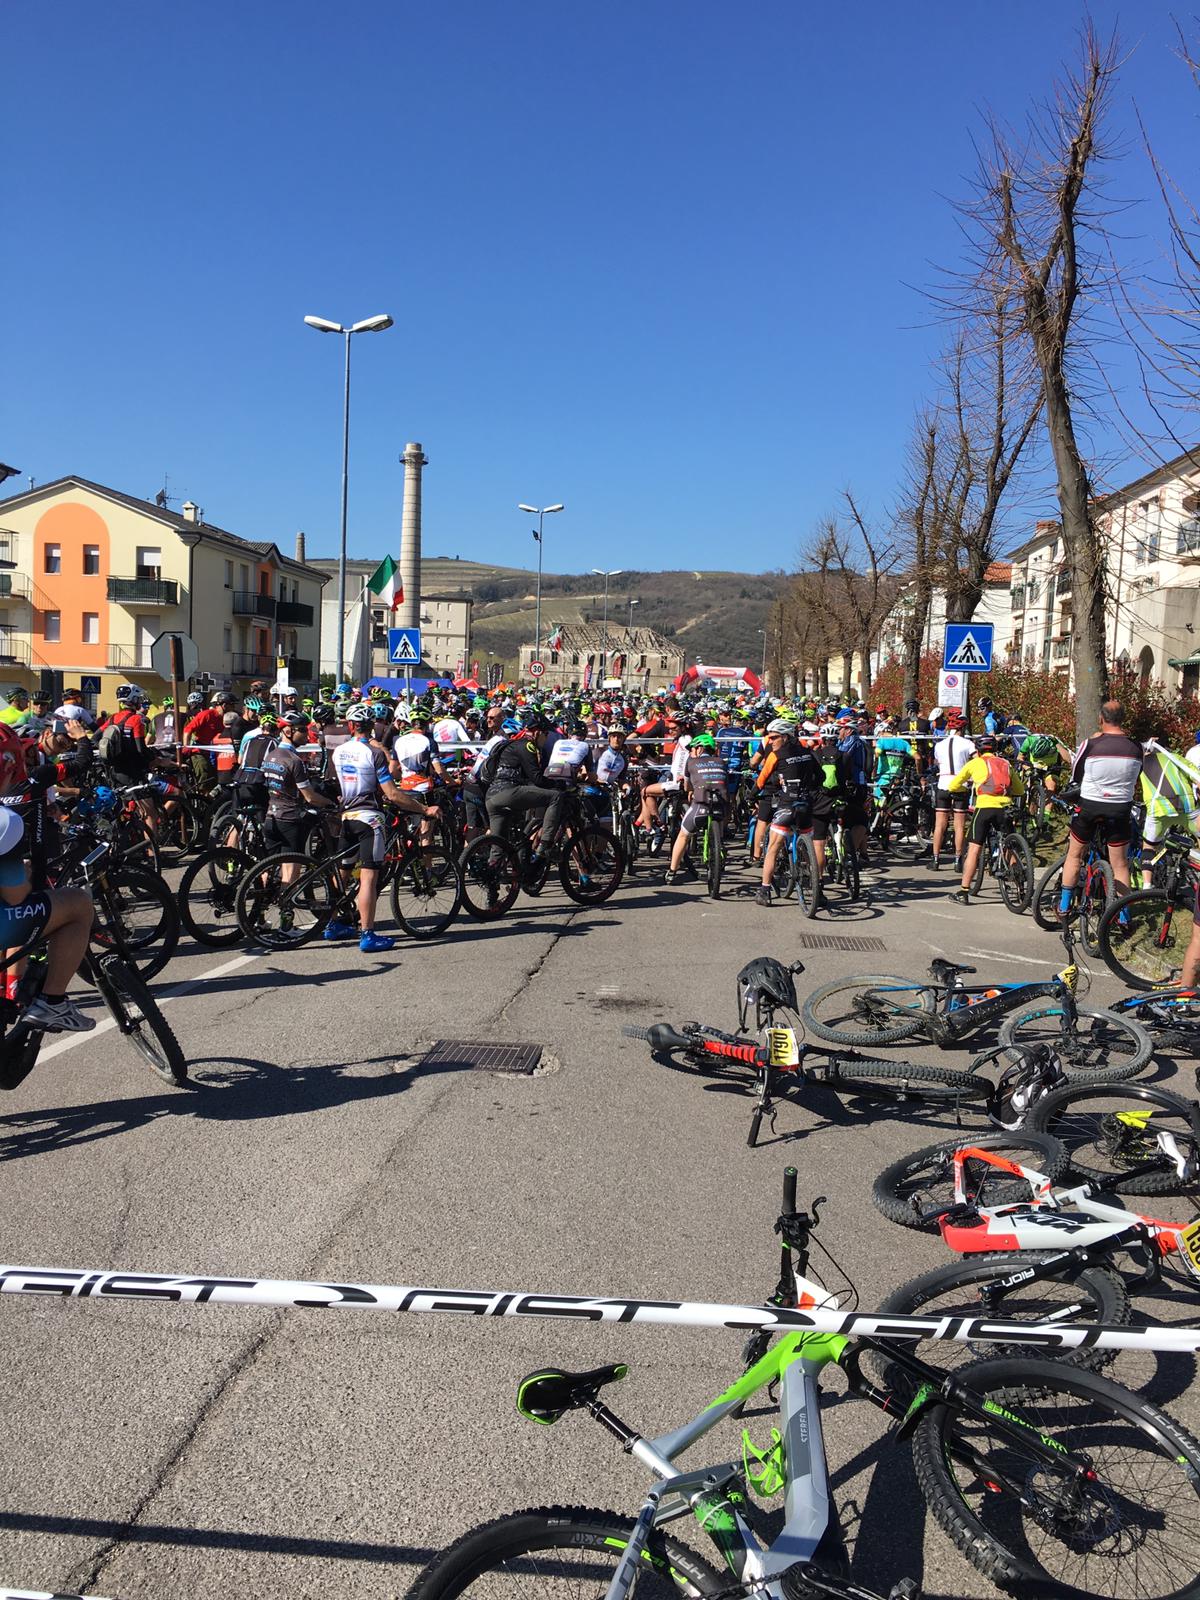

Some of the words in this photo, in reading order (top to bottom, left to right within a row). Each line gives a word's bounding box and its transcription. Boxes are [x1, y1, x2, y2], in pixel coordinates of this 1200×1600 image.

[532, 665, 542, 673] 30
[4, 902, 46, 921] TEAM
[772, 1031, 789, 1061] 1790
[0, 1270, 258, 1303] GIST
[1001, 1267, 1036, 1288] AION
[397, 1289, 683, 1323] GIST
[838, 1312, 1148, 1349] GIST
